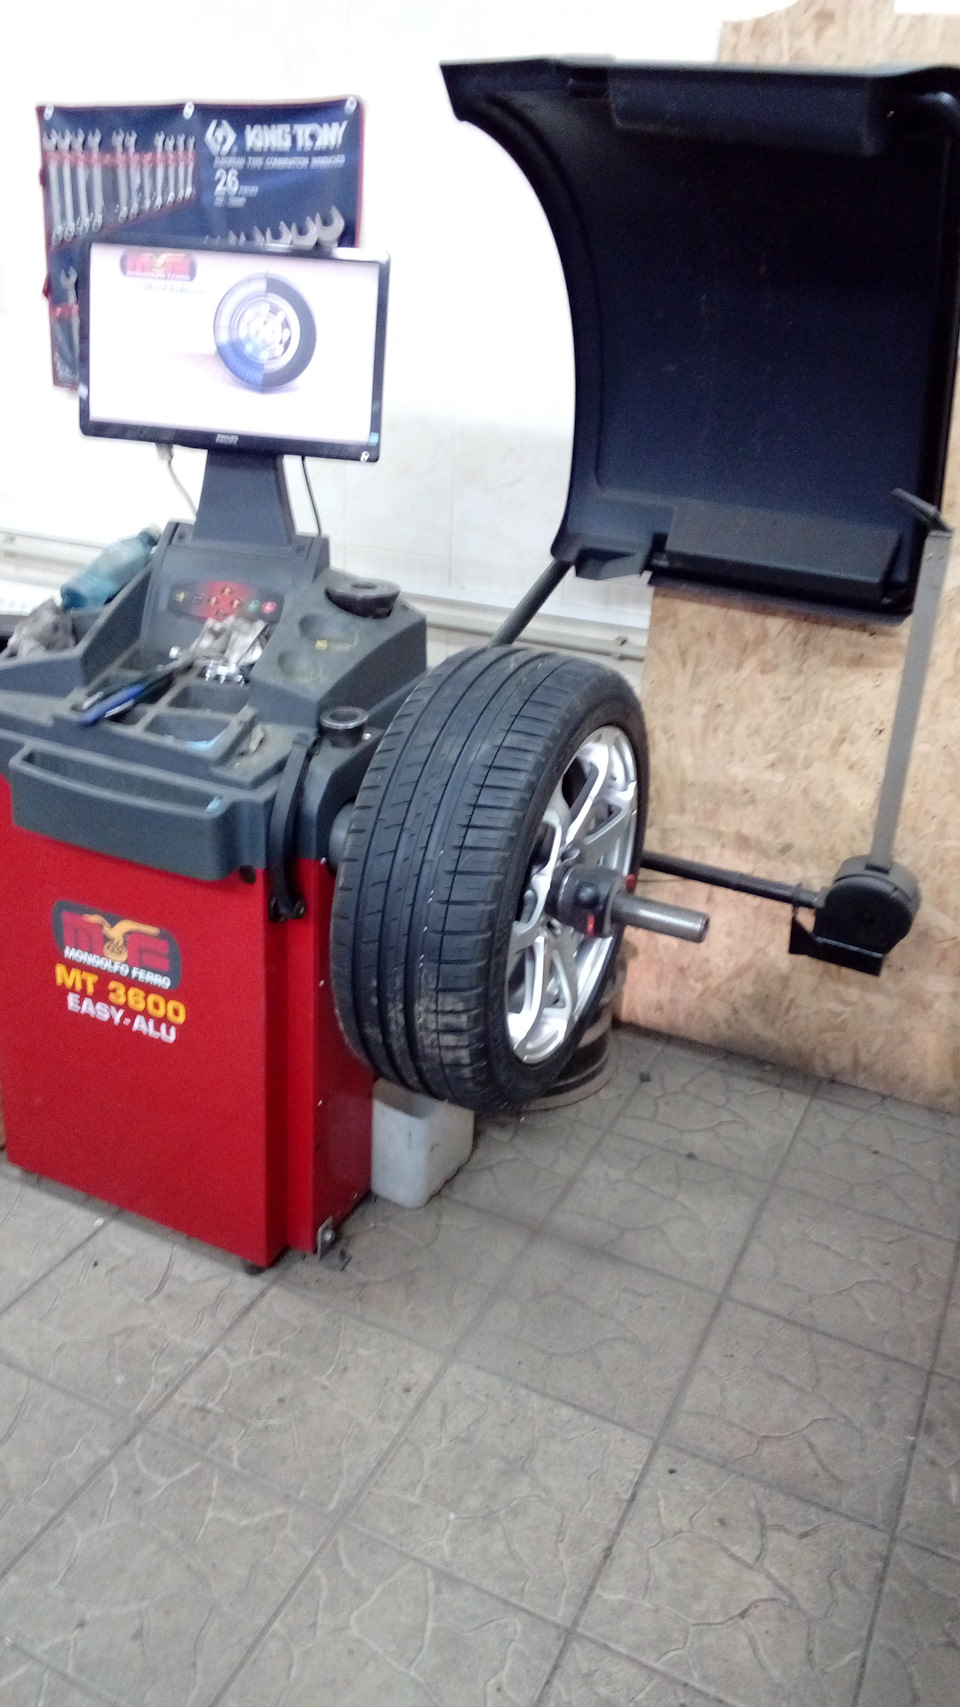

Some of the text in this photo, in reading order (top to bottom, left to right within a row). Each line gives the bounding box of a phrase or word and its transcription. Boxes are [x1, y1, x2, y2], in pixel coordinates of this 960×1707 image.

[244, 120, 348, 152] KING TONY
[214, 168, 239, 196] 26
[64, 945, 171, 990] MONDOLFO FERRO
[55, 962, 186, 1025] MT 3600
